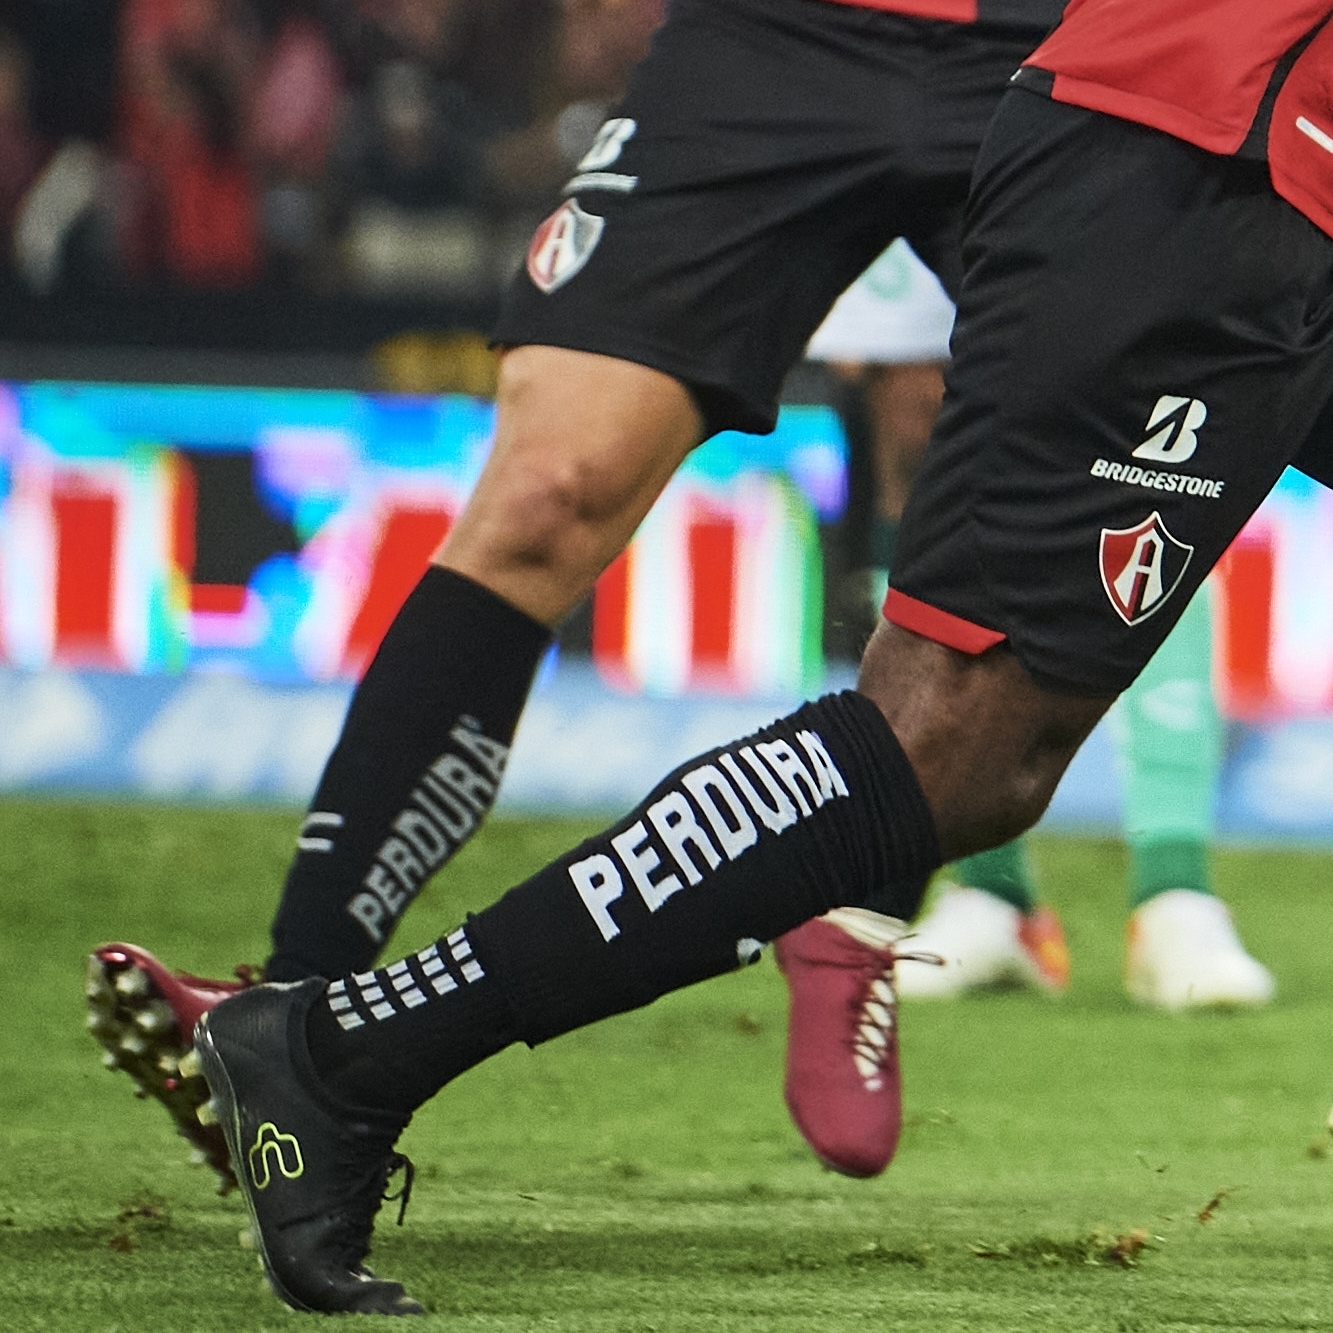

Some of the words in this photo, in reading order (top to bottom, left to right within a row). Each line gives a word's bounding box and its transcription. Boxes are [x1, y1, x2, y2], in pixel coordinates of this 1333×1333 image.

[1090, 458, 1226, 499] BRIDGESTONE
[346, 722, 511, 945] PERDURA
[567, 729, 850, 943] PERDURA
